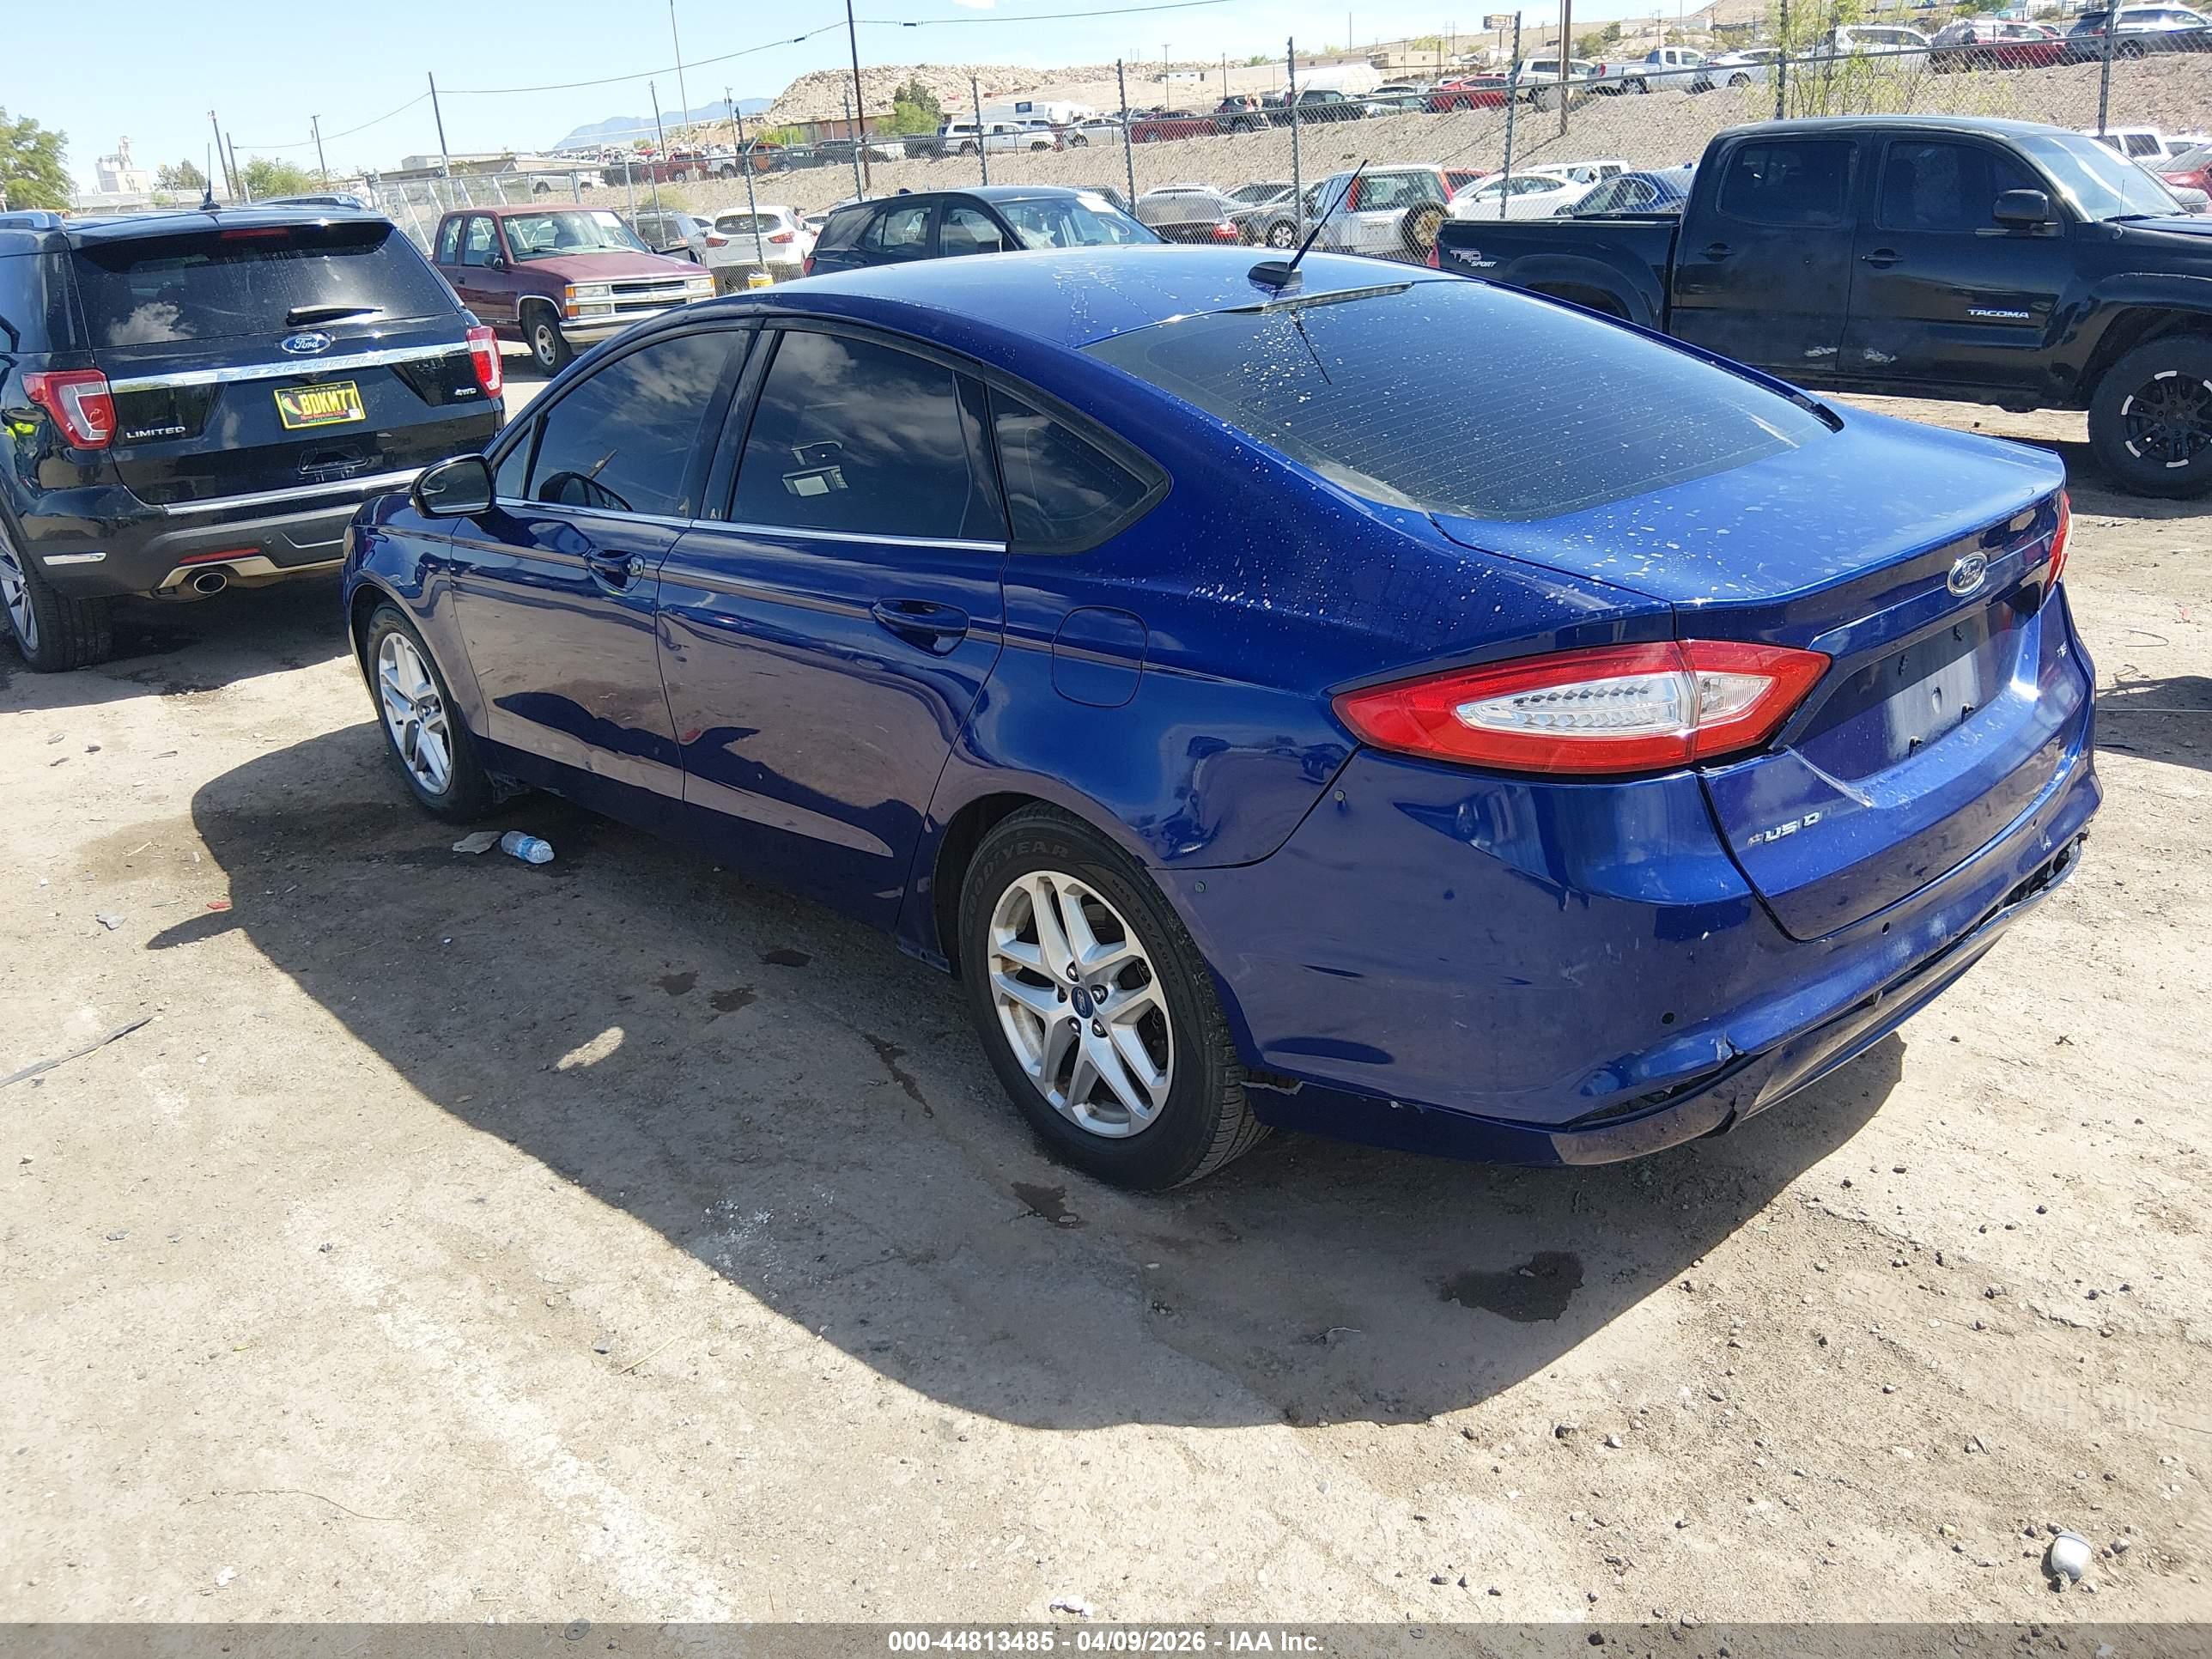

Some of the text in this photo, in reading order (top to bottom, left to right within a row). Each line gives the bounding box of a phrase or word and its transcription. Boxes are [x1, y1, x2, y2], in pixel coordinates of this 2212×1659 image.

[1449, 250, 1482, 263] TRD
[1967, 309, 2030, 319] TACOMA
[294, 337, 319, 349] Ford
[454, 387, 477, 396] 4WD
[298, 389, 357, 416] BDKM77
[126, 426, 186, 439] LIMITED
